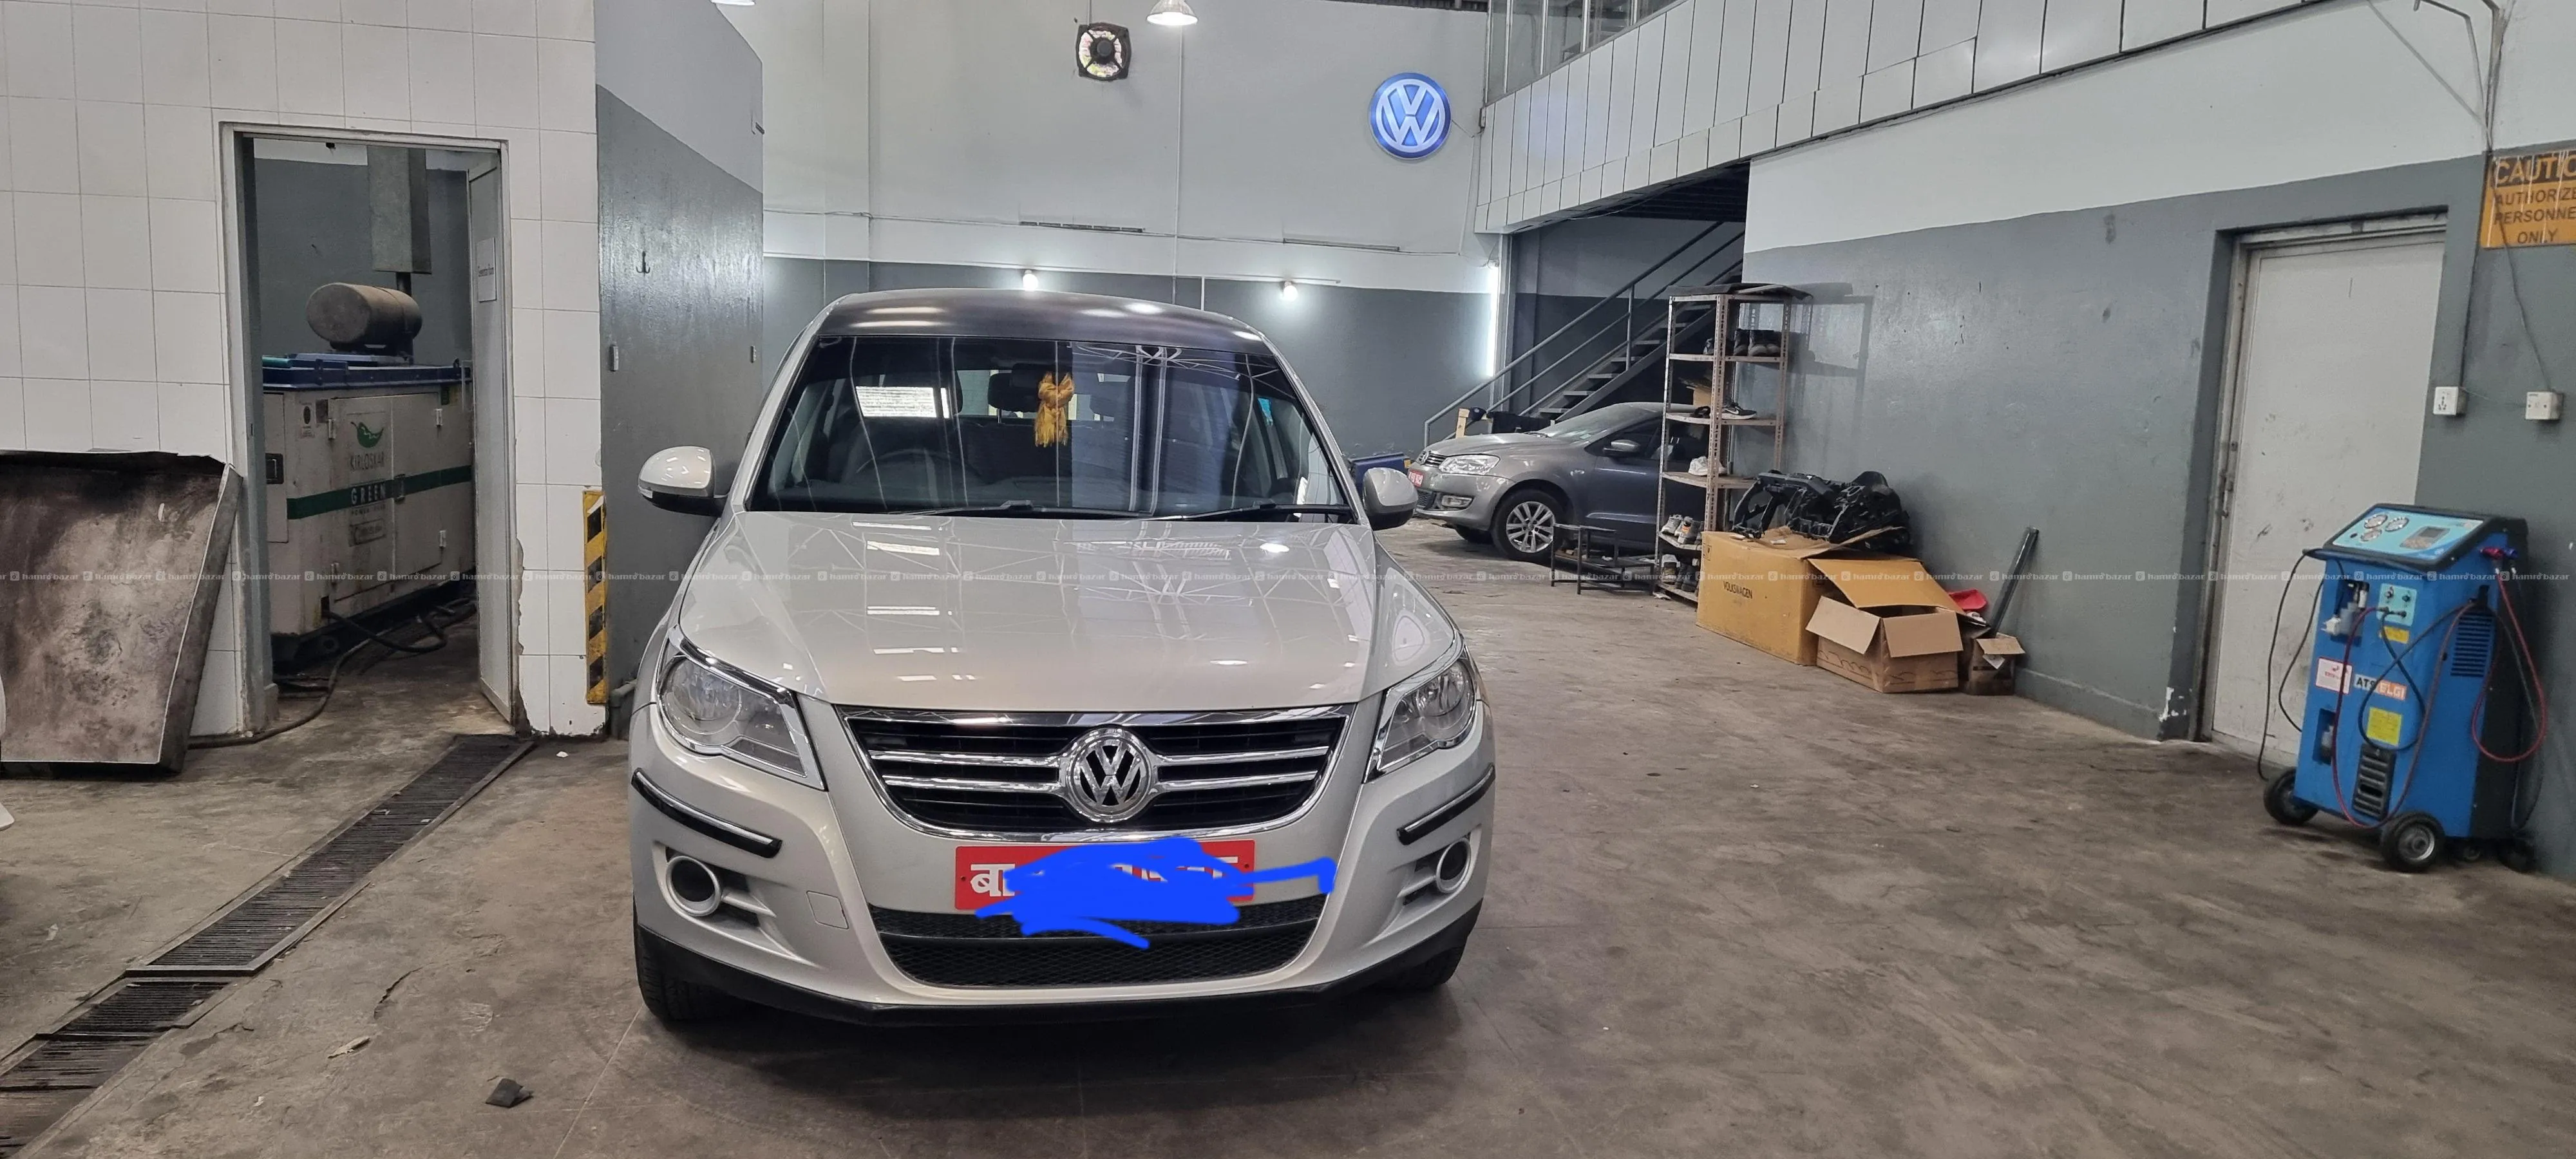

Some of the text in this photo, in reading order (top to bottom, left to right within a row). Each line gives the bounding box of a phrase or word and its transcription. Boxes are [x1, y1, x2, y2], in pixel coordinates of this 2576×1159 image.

[1381, 82, 1444, 147] VW
[2517, 228, 2558, 244] ONLY
[351, 483, 386, 505] GREEN
[1079, 738, 1144, 807] VW
